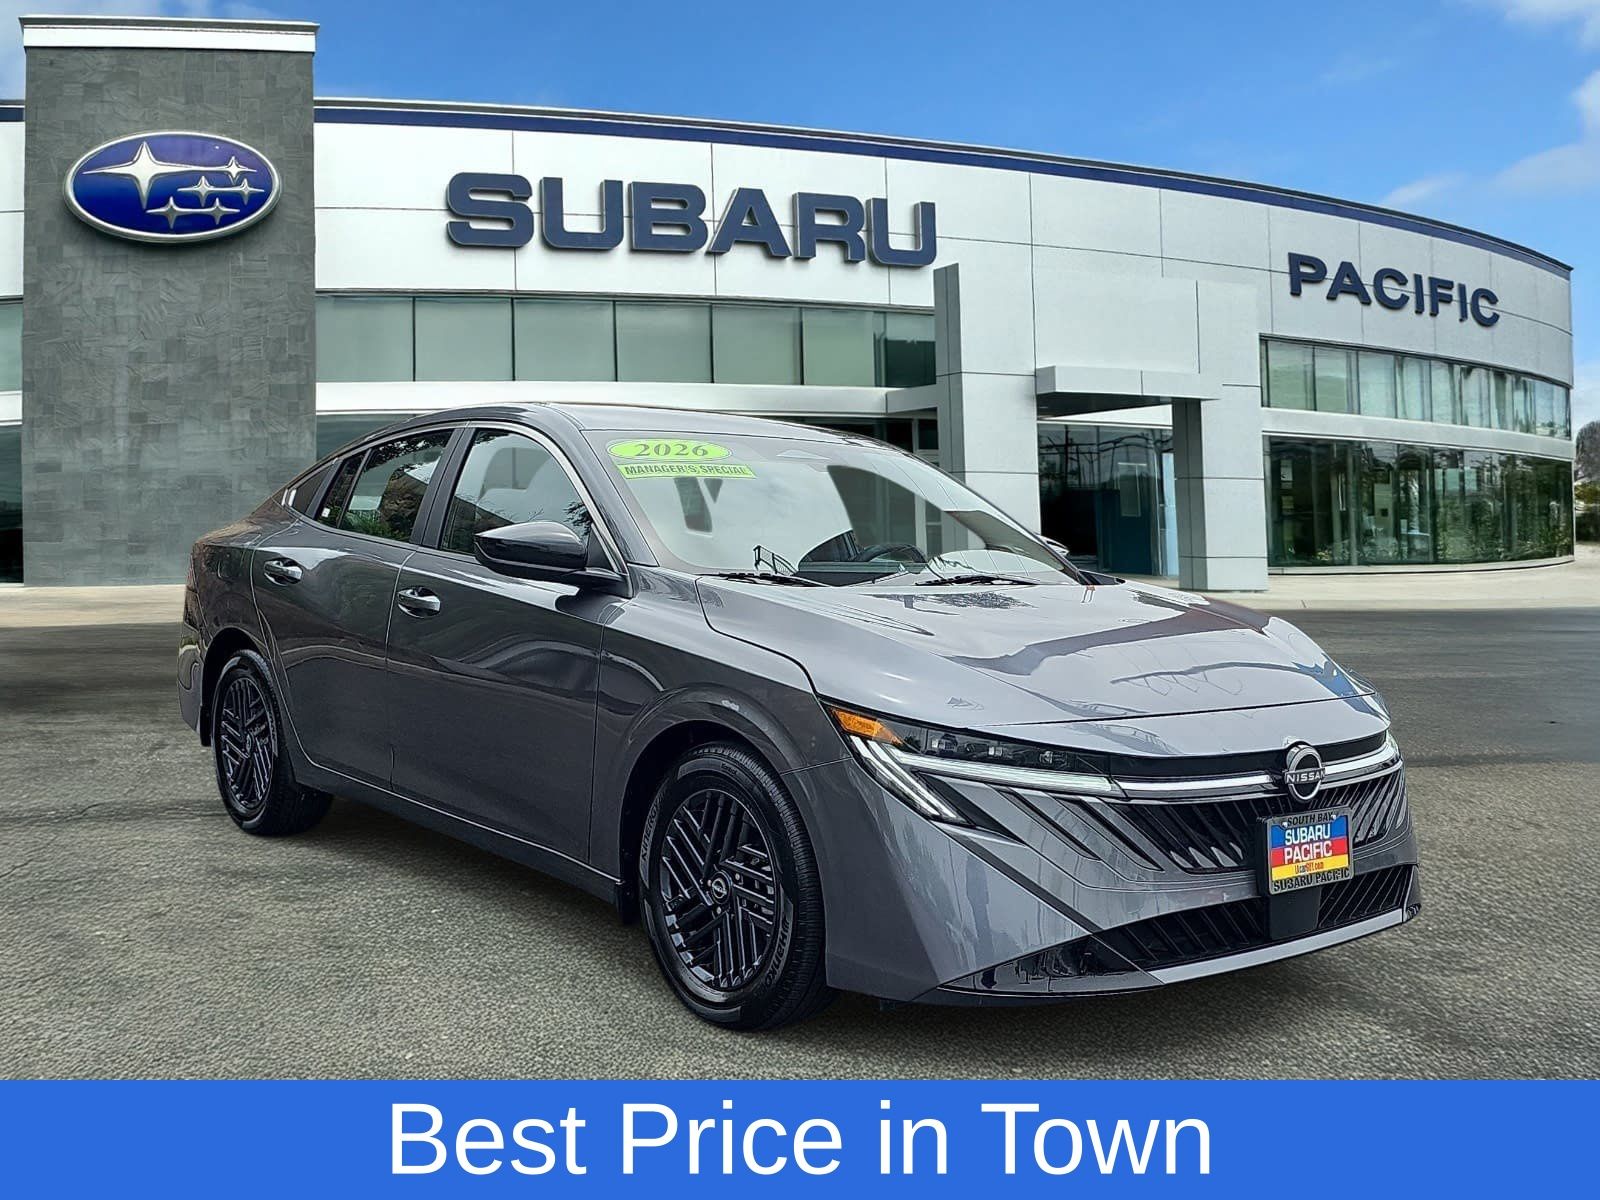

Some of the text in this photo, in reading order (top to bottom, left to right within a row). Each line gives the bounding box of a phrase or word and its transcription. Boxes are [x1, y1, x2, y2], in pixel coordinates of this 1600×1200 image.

[446, 171, 937, 268] SUBARU
[1287, 251, 1500, 328] PACIFIC
[634, 443, 709, 457] 2026
[624, 464, 746, 475] MANAGER'S SPECIAL
[1286, 768, 1326, 784] NISSAN
[1287, 811, 1334, 826] SOUTH BAY
[1285, 823, 1331, 846] SUBARU
[1283, 840, 1333, 865] PACIFIC
[1273, 867, 1350, 892] SUBARU PACIFIC
